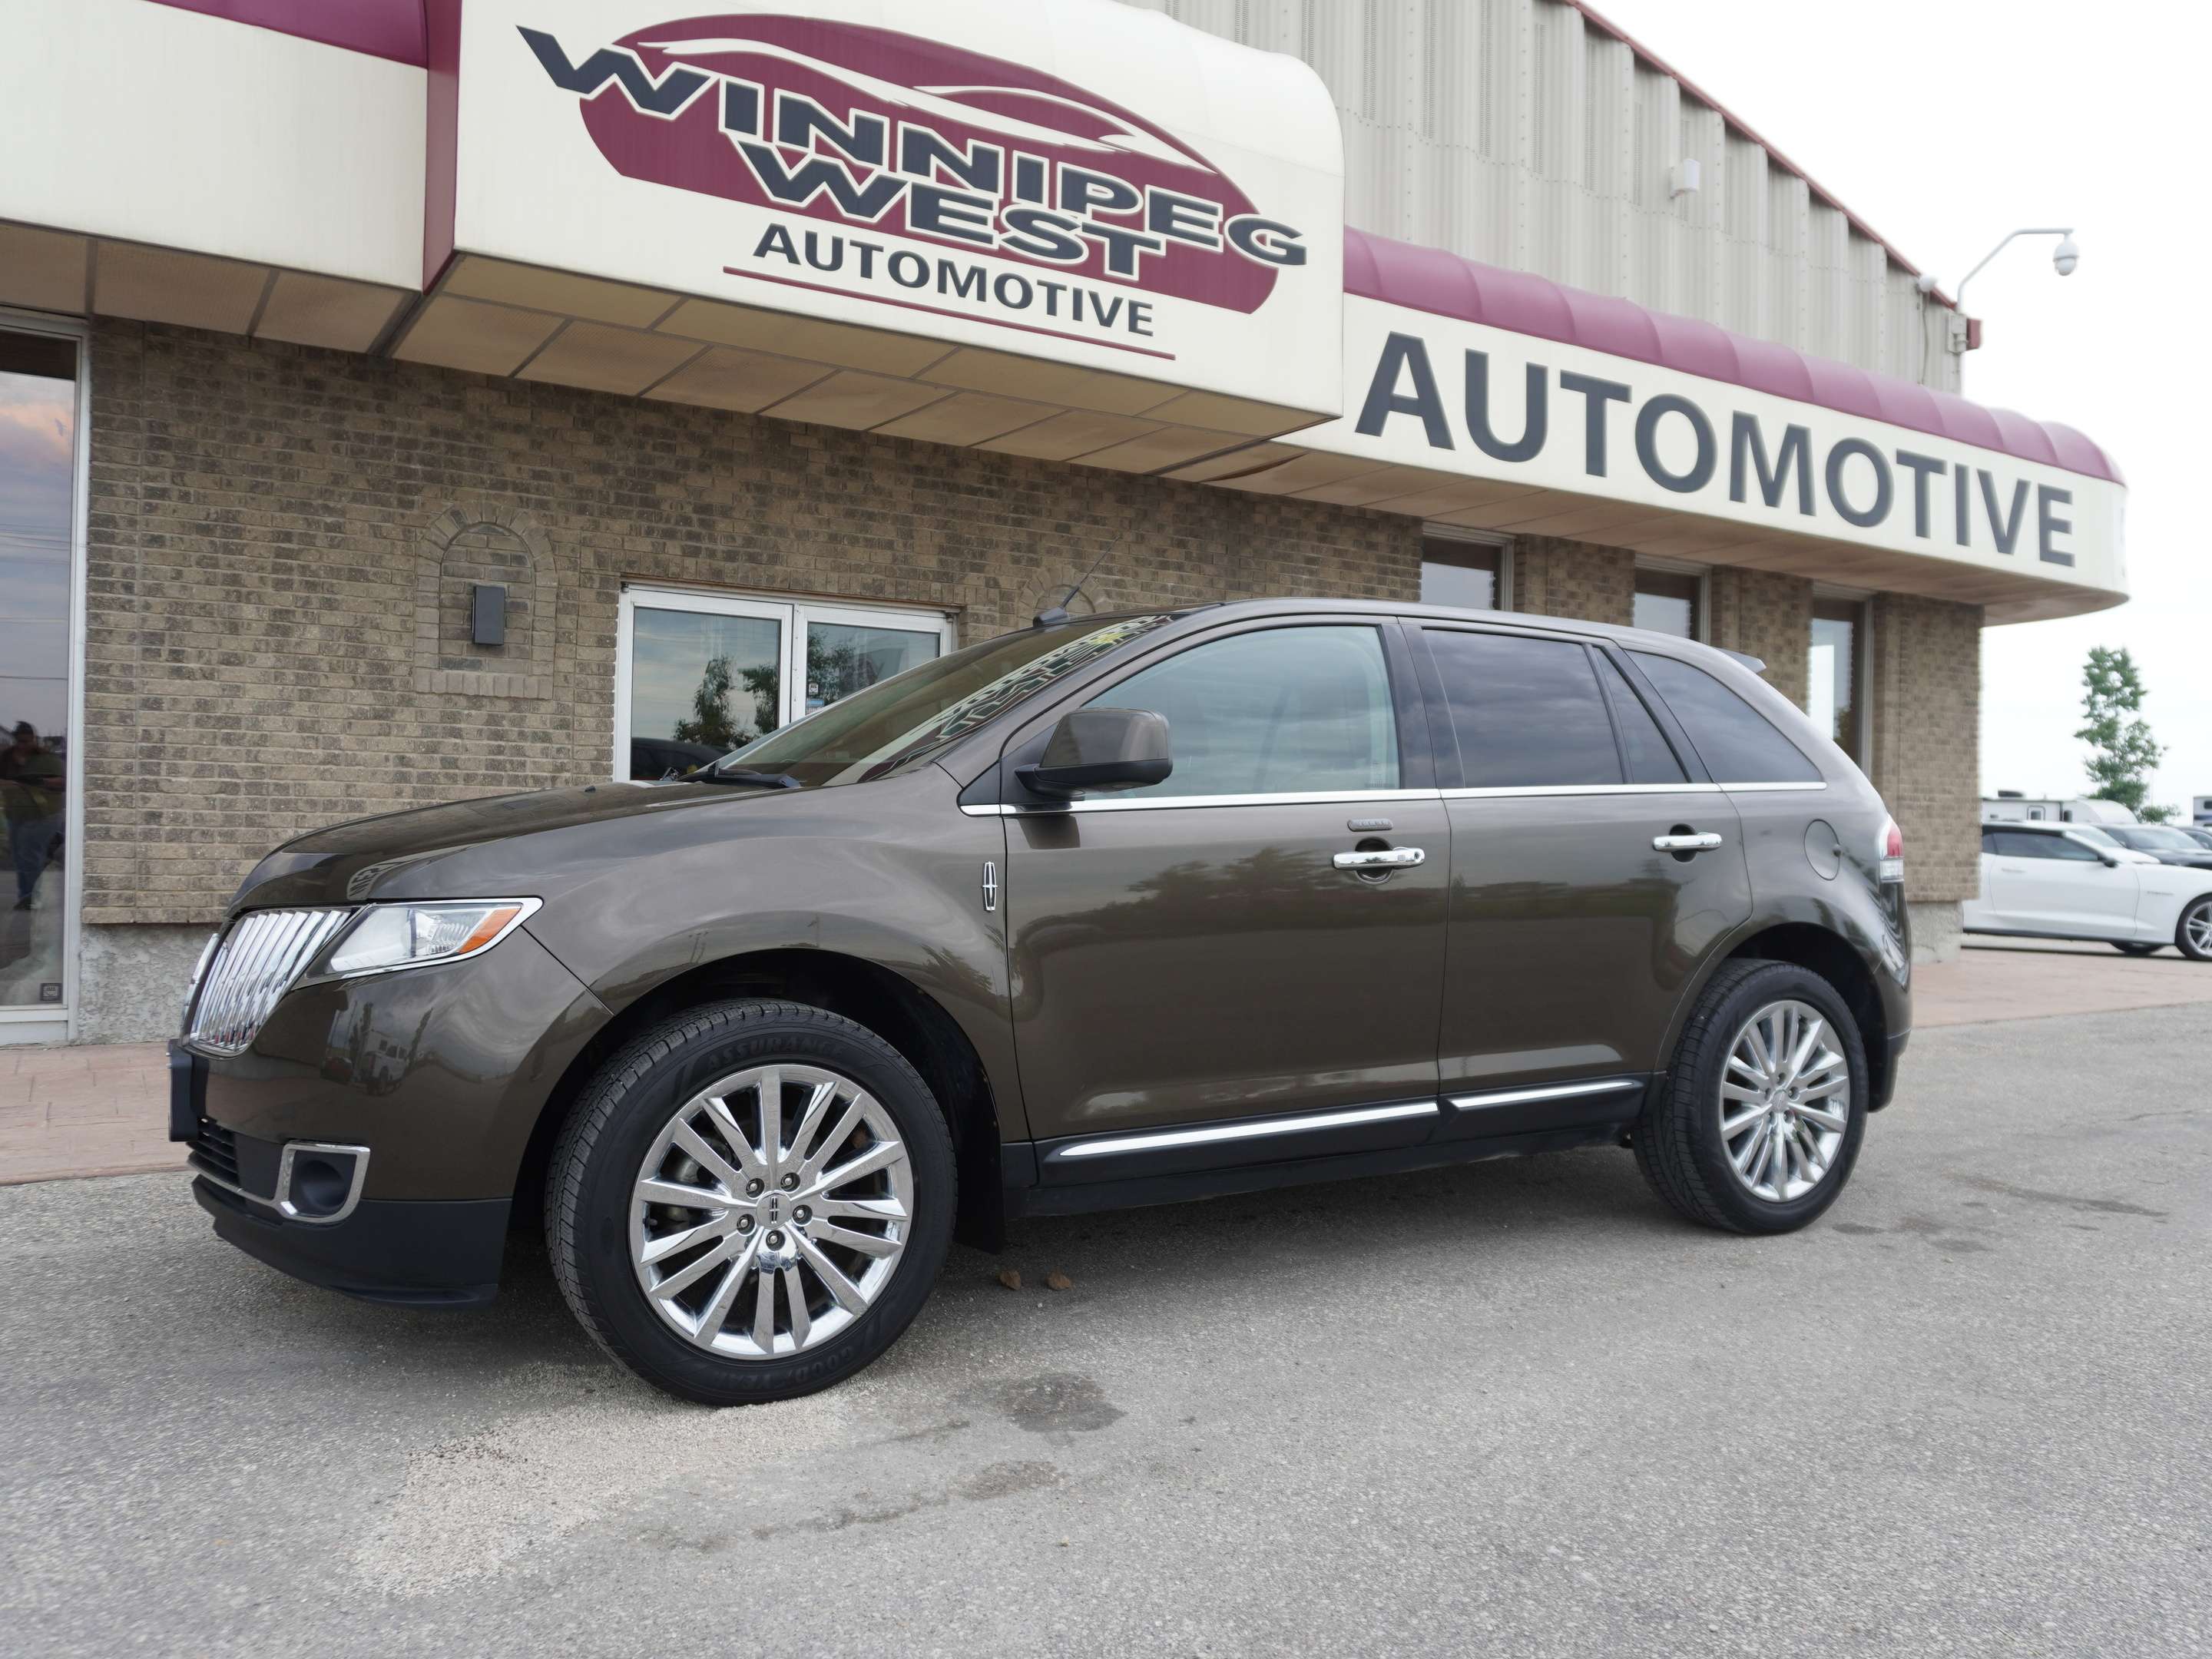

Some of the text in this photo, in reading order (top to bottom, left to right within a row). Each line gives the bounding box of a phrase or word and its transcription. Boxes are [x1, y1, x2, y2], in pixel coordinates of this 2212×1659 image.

[516, 25, 1306, 267] WINNIPEG
[738, 141, 1166, 280] WEST
[753, 223, 1154, 337] AUTOMOTIVE
[1354, 331, 2076, 568] AUTOMOTIVE
[707, 1036, 845, 1069] ASSURANCE
